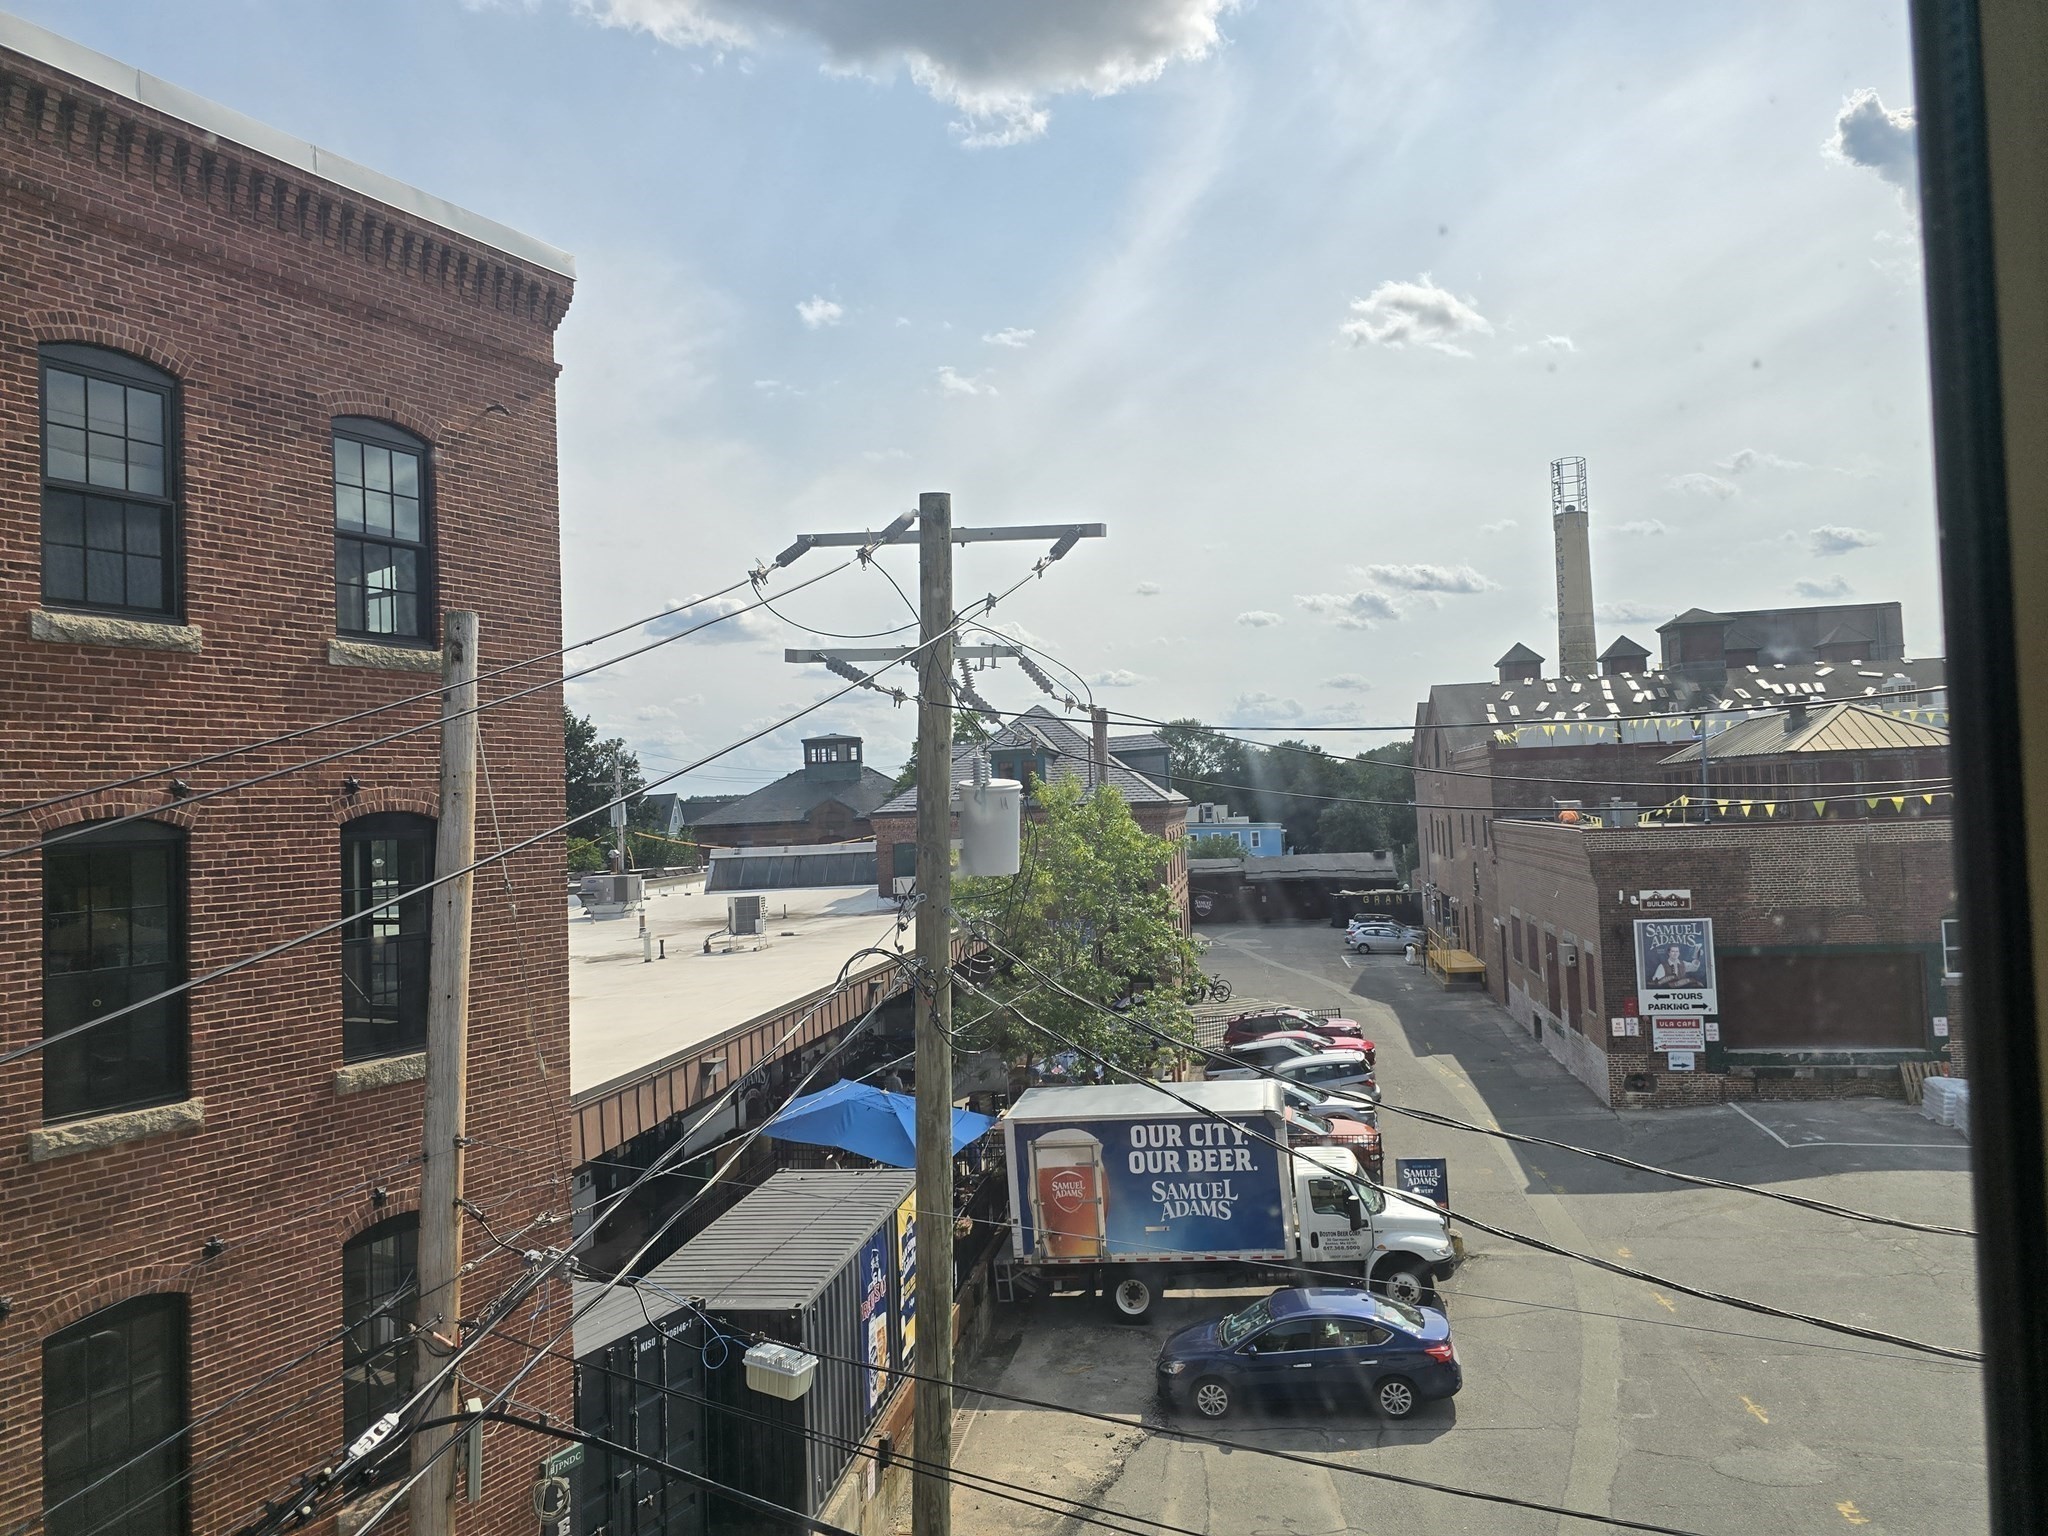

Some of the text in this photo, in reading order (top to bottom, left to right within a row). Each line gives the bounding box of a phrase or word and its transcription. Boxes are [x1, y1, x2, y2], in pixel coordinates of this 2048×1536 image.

[1363, 894, 1413, 904] GRANT
[1646, 923, 1701, 937] SAMUEL
[1650, 934, 1697, 950] ADAMS
[1648, 1003, 1690, 1011] PARKING
[1130, 1122, 1249, 1148] OUR CITY.
[1128, 1148, 1258, 1174] OUR BEER.
[1403, 1168, 1441, 1179] SAMUEL
[1052, 1180, 1086, 1191] SAMUEL
[1407, 1177, 1438, 1187] ADAMS
[1055, 1189, 1083, 1199] ADAMS
[1151, 1179, 1239, 1203] SAMUEL
[1160, 1200, 1232, 1222] ADAMS
[640, 1337, 656, 1352] KISU
[555, 1451, 582, 1475] JPNDC
